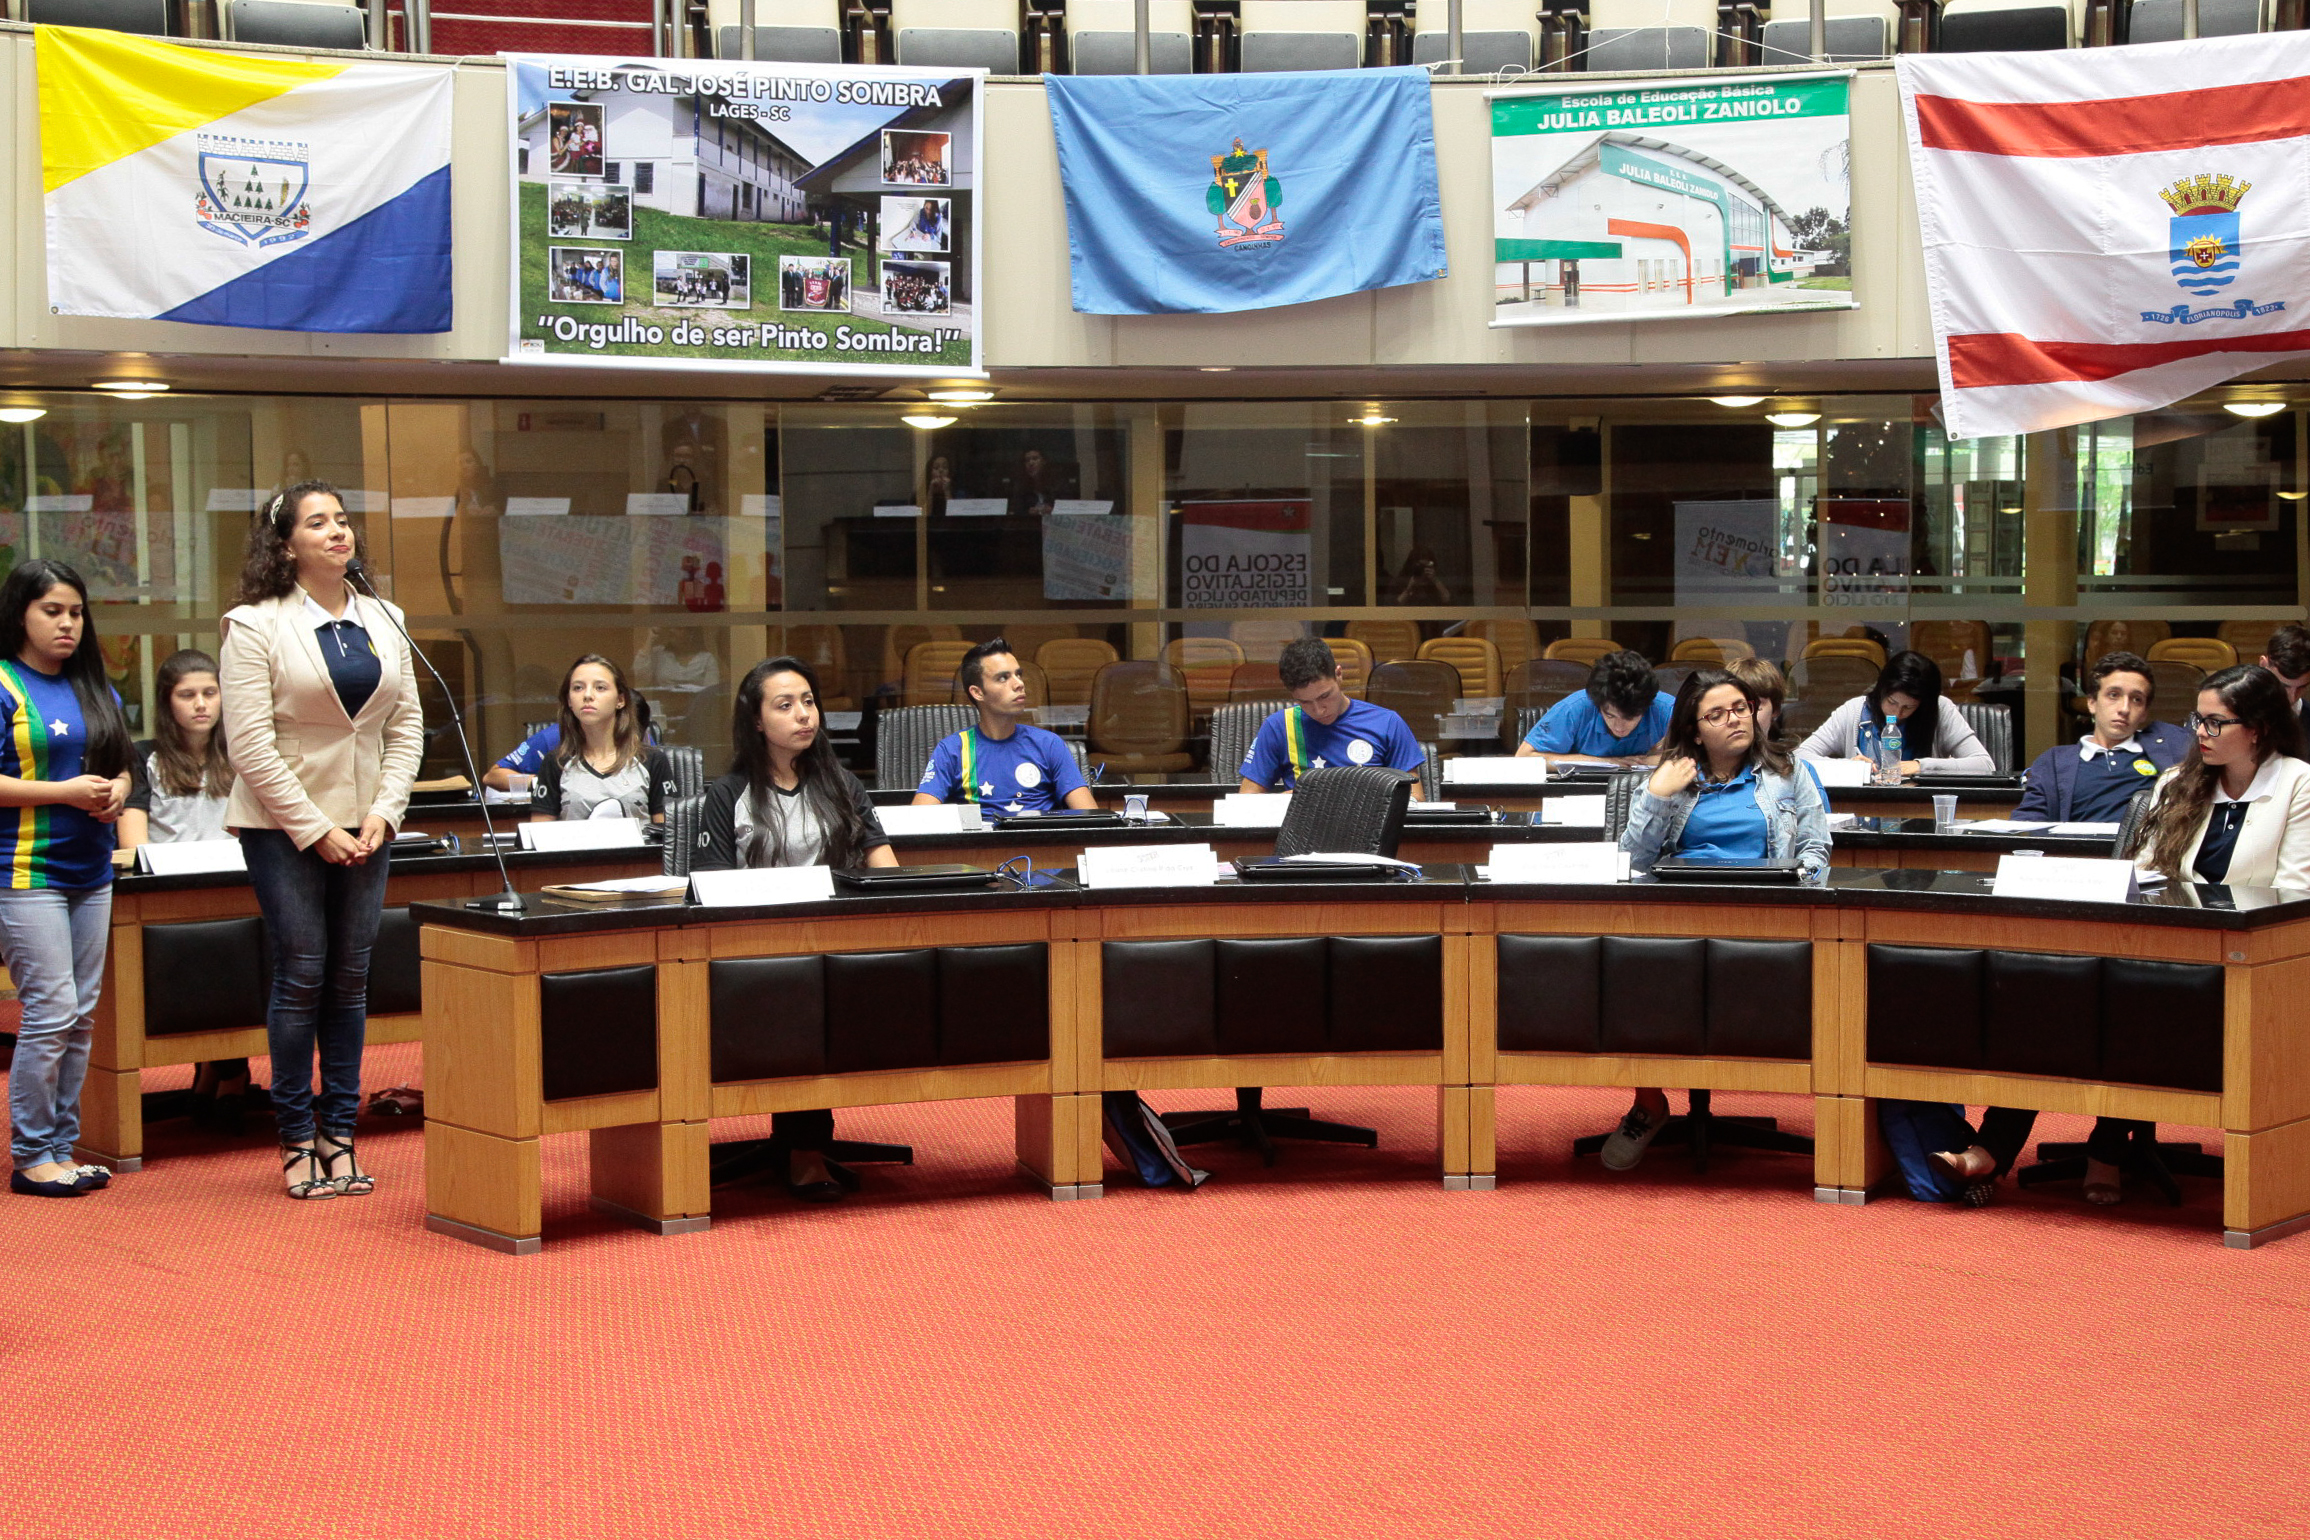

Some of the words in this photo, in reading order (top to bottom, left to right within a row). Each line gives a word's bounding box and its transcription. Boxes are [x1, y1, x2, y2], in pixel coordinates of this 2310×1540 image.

[550, 67, 620, 91] E.E.B.
[627, 71, 680, 95] GAL
[684, 70, 748, 98] JOSÉ
[755, 76, 832, 102] PINTO
[837, 80, 943, 107] SOMBRA
[1561, 94, 1612, 109] Escola
[1617, 91, 1636, 105] de
[1641, 88, 1715, 104] Educação
[1721, 83, 1775, 98] Básica
[709, 103, 759, 120] LAGES
[769, 106, 791, 121] SC
[1537, 111, 1600, 130] JULIA
[1606, 104, 1697, 126] BALEOLI
[1703, 98, 1801, 119] ZANIOLO
[1618, 163, 1652, 182] JULIA
[1653, 172, 1688, 192] BALEOLI
[214, 213, 291, 227] MACIEIRA-SC
[671, 319, 706, 346] de
[712, 327, 754, 347] ser
[760, 323, 829, 350] Pinto
